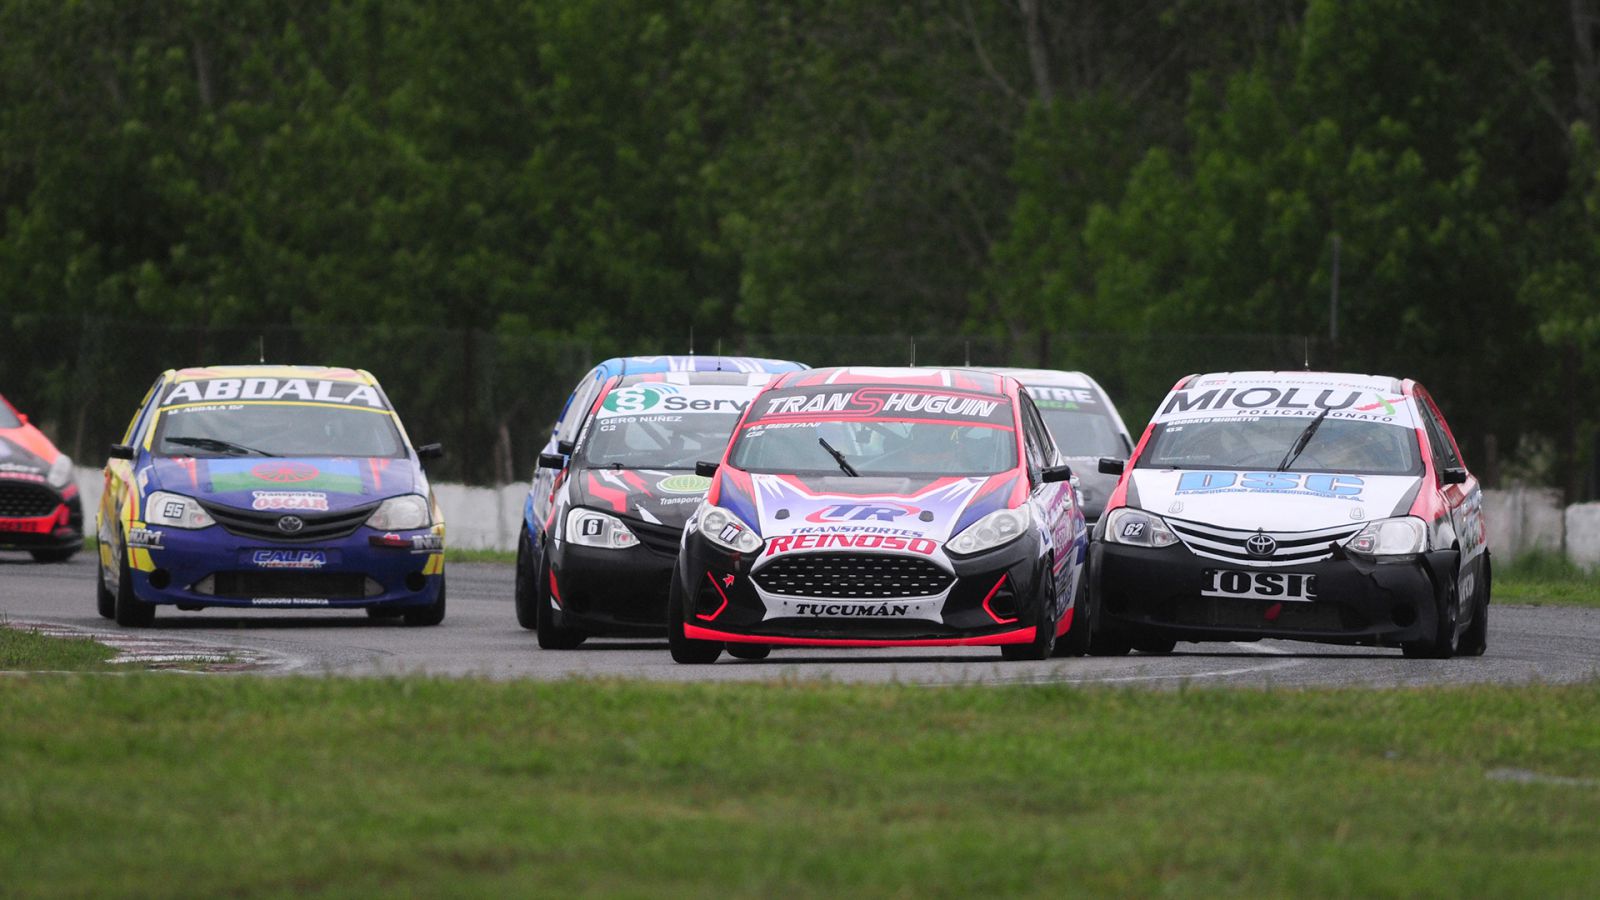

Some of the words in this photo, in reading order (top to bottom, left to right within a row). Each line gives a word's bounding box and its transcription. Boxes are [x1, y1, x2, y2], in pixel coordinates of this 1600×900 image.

[164, 378, 383, 408] ABDALA
[664, 396, 749, 411] Serv
[765, 387, 998, 417] TRANSHUGUIN
[601, 417, 637, 425] GERO
[640, 415, 682, 423] NUÑEZ
[1176, 472, 1365, 496] DSC
[165, 502, 184, 518] 95
[253, 497, 328, 510] OSCAR
[827, 504, 907, 522] TR
[587, 519, 600, 535] 6
[791, 525, 925, 538] TRANSPORTES
[1124, 523, 1144, 536] 62
[766, 534, 938, 557] REINOSO
[253, 550, 327, 564] CALPA
[796, 603, 909, 616] TUCUMÁN
